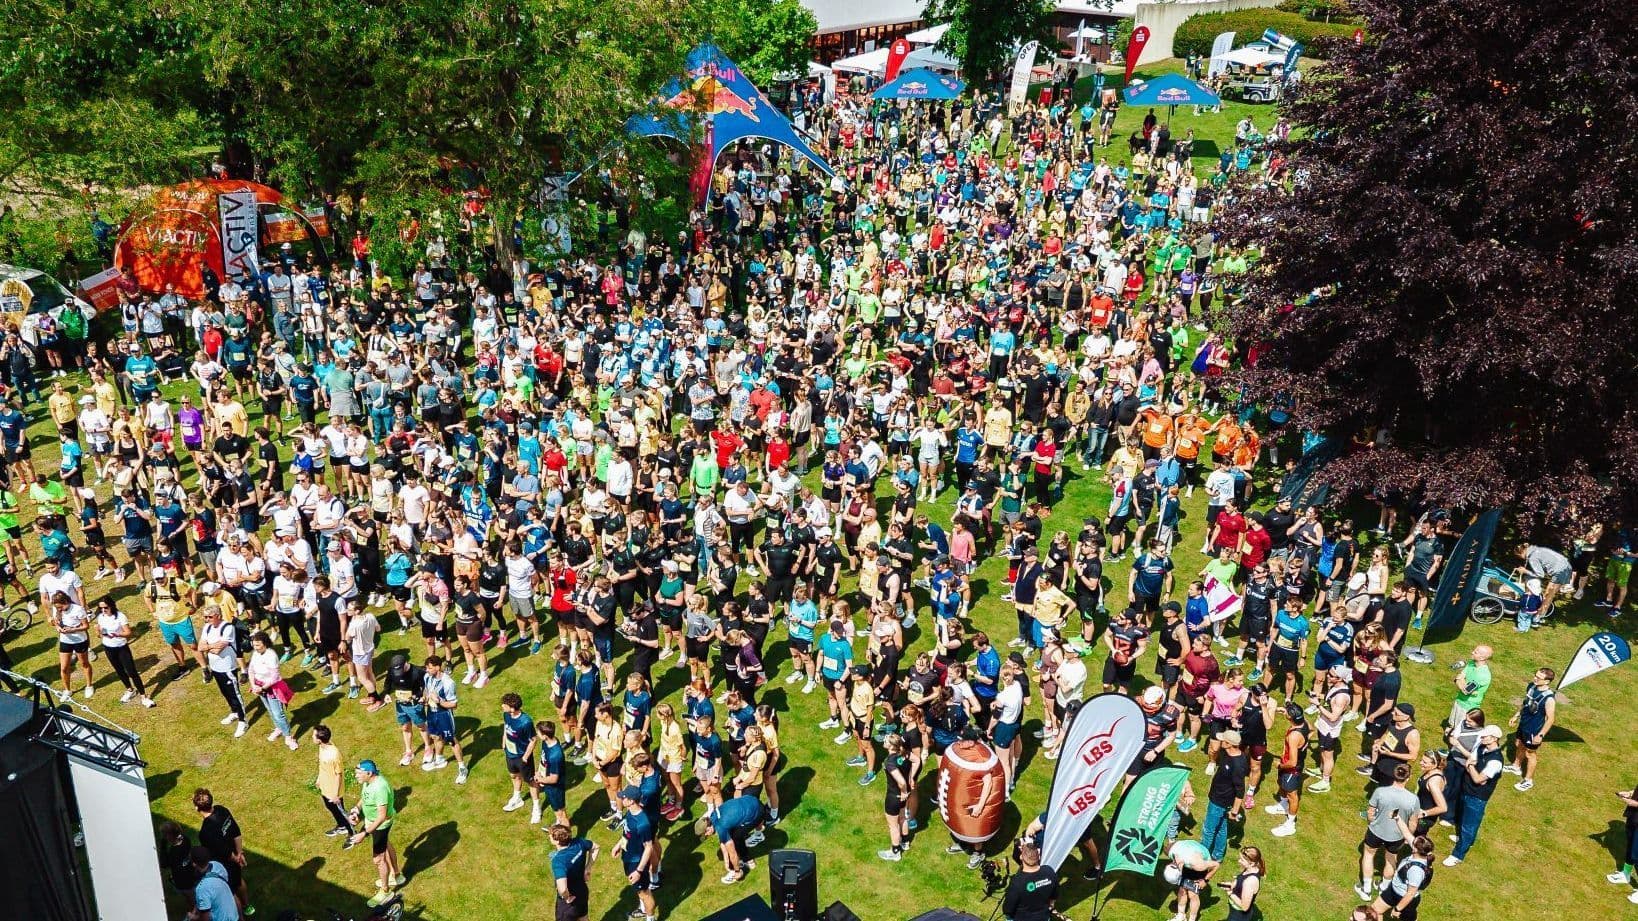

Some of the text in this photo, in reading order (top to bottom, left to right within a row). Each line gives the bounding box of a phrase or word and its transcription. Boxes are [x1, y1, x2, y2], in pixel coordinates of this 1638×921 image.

[1020, 41, 1036, 60] OPEN
[709, 61, 736, 82] Bull
[1598, 635, 1617, 651] 20
[1082, 740, 1113, 767] LBS
[1067, 791, 1097, 816] LBS
[1137, 786, 1157, 825] STRONG
